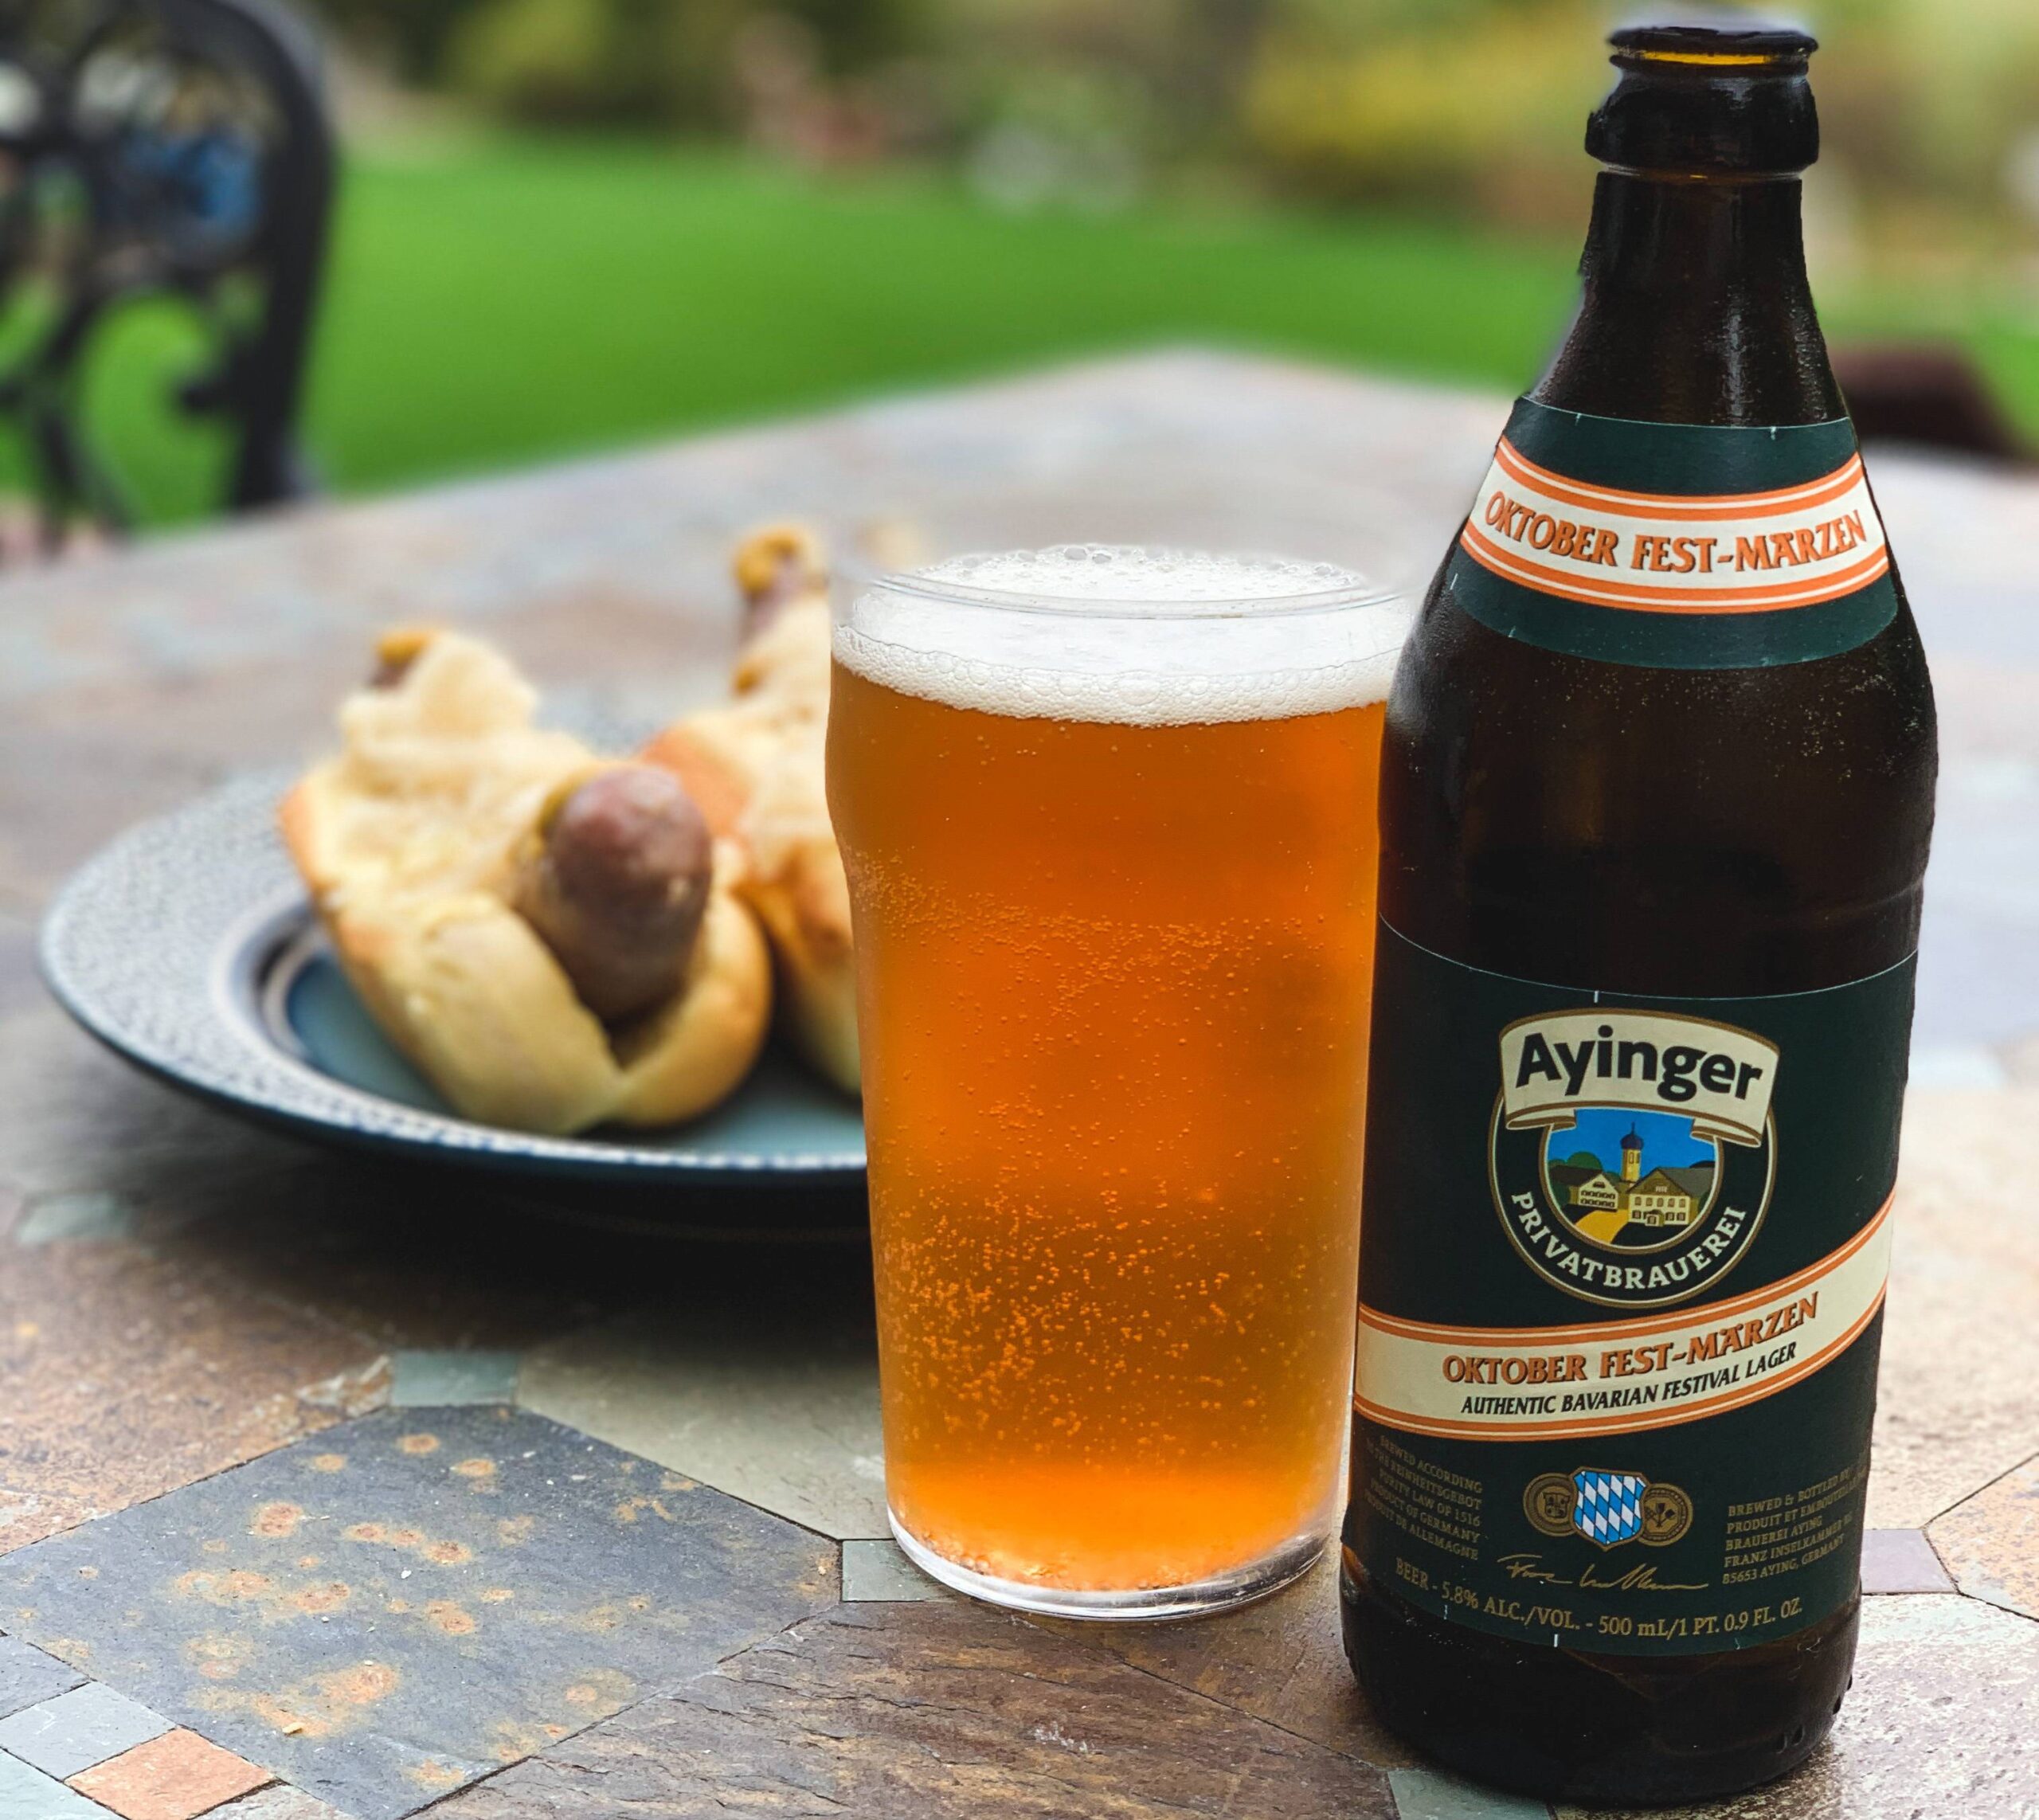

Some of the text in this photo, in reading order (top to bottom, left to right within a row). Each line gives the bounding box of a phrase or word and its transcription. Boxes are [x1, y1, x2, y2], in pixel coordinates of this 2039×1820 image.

[1485, 490, 1618, 568] OKTOBER
[1516, 1025, 1763, 1102] Ayinger
[1512, 1192, 1747, 1290] PRIVATBRAUEREI
[1442, 1291, 1819, 1386] OKTOBER FEST-MÄRZEN
[1461, 1342, 1796, 1415] AUTHENTIC BAVARIAN FESTIVAL LAGER
[1417, 1459, 1483, 1494] ACCORDING
[1728, 1497, 1783, 1517] BREWED
[1785, 1495, 1794, 1505] &
[1798, 1475, 1838, 1502] BOTTLED
[1406, 1504, 1419, 1519] OF
[1419, 1512, 1481, 1544] GERMANY
[1411, 1489, 1435, 1509] LAW
[1437, 1502, 1452, 1517] OF
[1454, 1509, 1481, 1528] 1516
[1727, 1513, 1783, 1534] PRODUIT
[1784, 1509, 1798, 1523] ET
[1395, 1513, 1408, 1530] DE
[1409, 1523, 1480, 1561] ALLEMAGNE
[1725, 1528, 1788, 1552] BRAUEREI
[1791, 1516, 1823, 1536] AYING
[1722, 1568, 1758, 1585] 85653
[1759, 1558, 1800, 1579] AYING,
[1801, 1533, 1845, 1566] GERMANY
[1724, 1550, 1767, 1568] FRANZ
[1395, 1556, 1429, 1591] BEER
[1442, 1582, 1478, 1610] 5.8%
[1483, 1597, 1580, 1631] ALC./VOL.
[1599, 1616, 1632, 1637] 500
[1693, 1615, 1720, 1635] PT.
[1724, 1612, 1748, 1631] 0.9
[1752, 1605, 1776, 1626] FL.
[1779, 1596, 1803, 1617] OZ.
